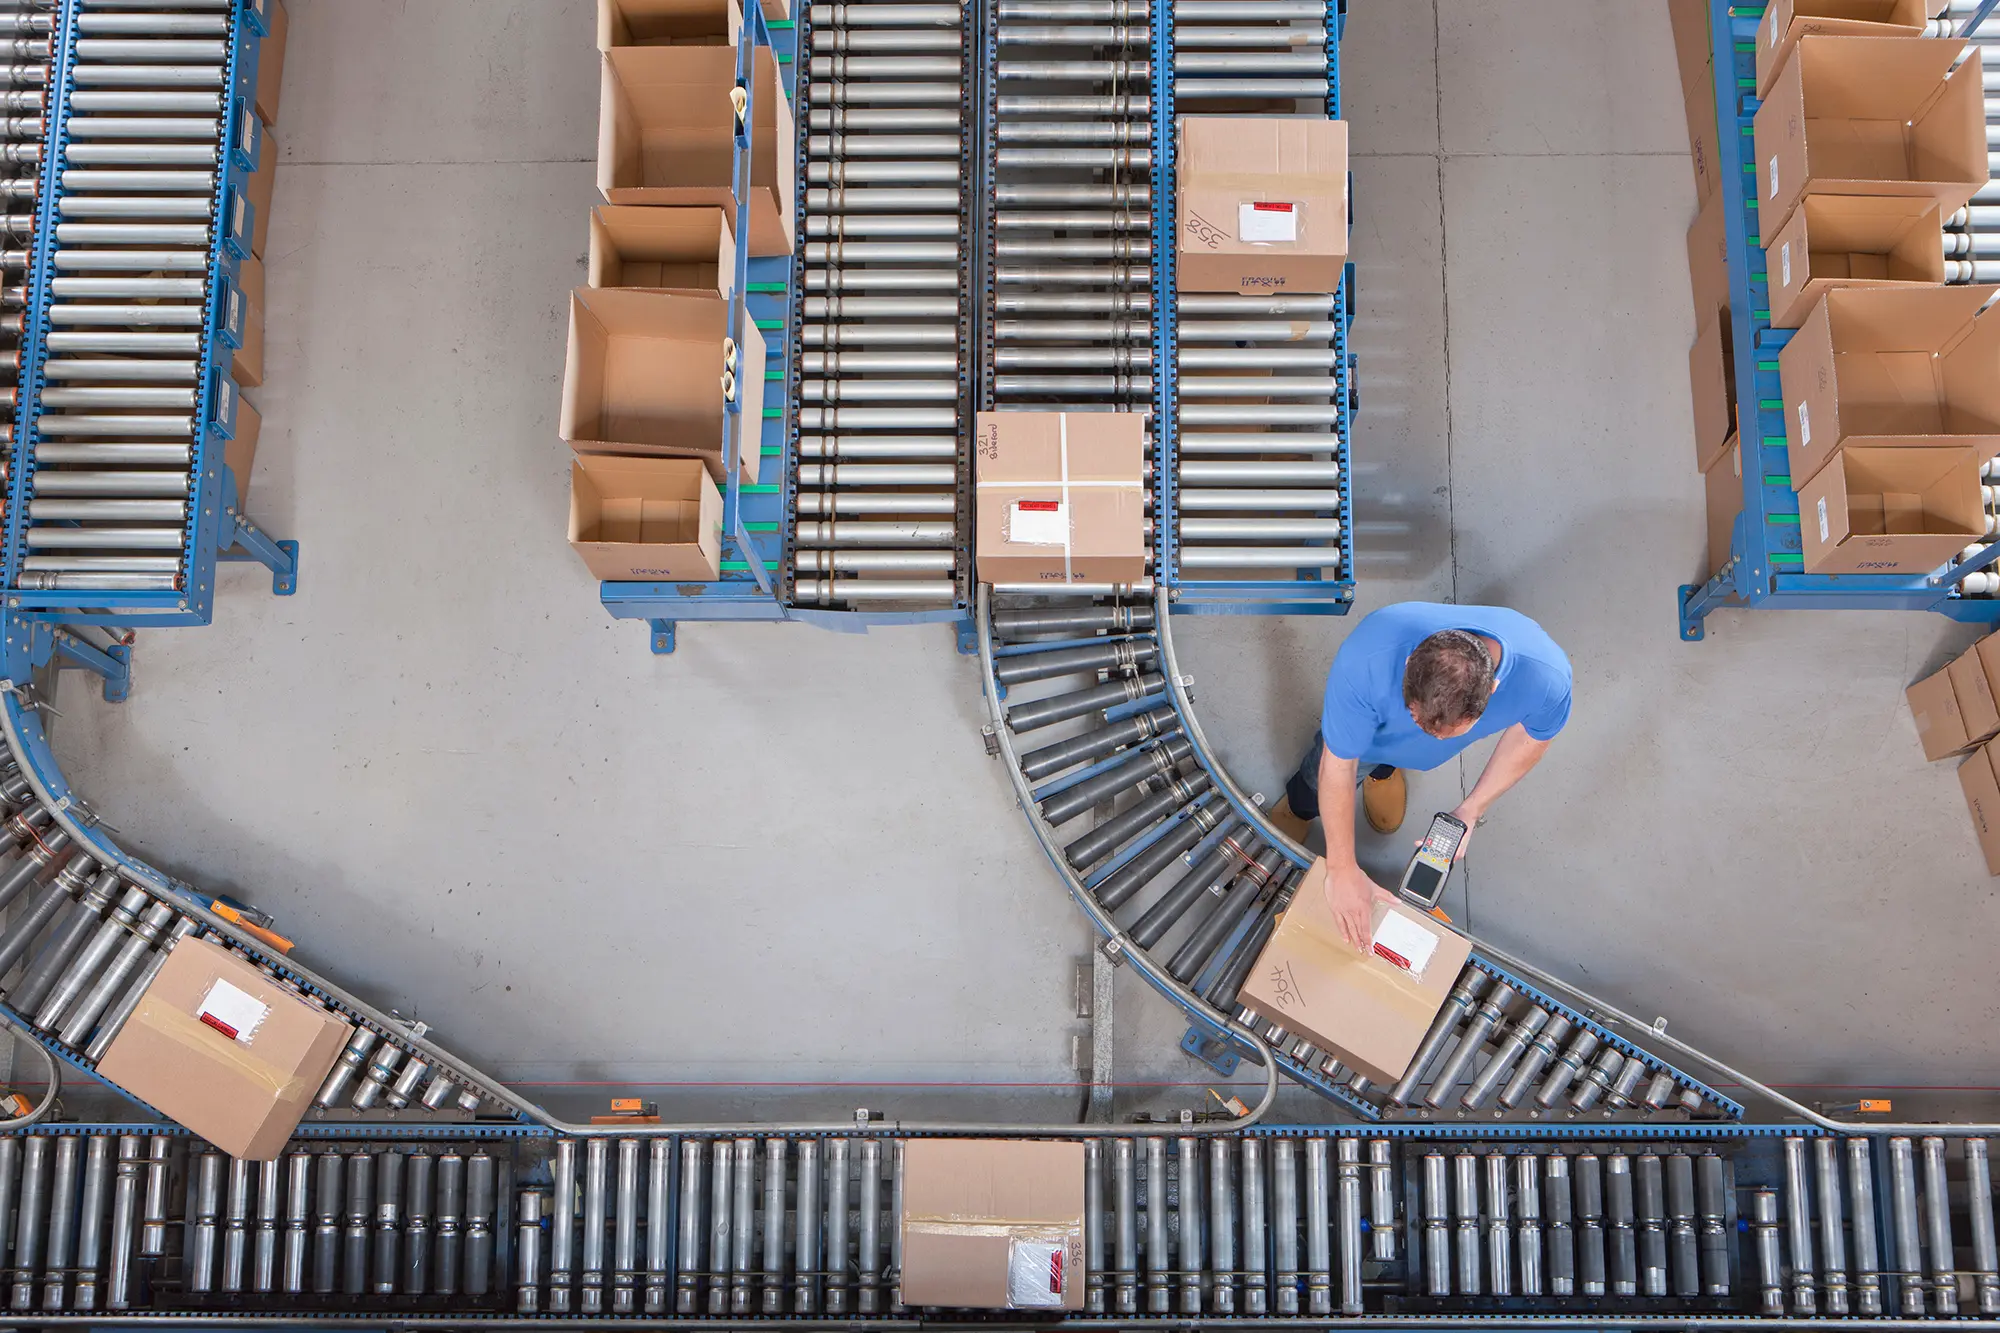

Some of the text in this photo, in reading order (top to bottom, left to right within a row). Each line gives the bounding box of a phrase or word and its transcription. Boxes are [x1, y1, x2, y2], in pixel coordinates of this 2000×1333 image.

[1185, 219, 1224, 250] 358
[978, 434, 989, 456] 321
[1270, 965, 1296, 1010] 364
[1071, 1241, 1083, 1267] 336
